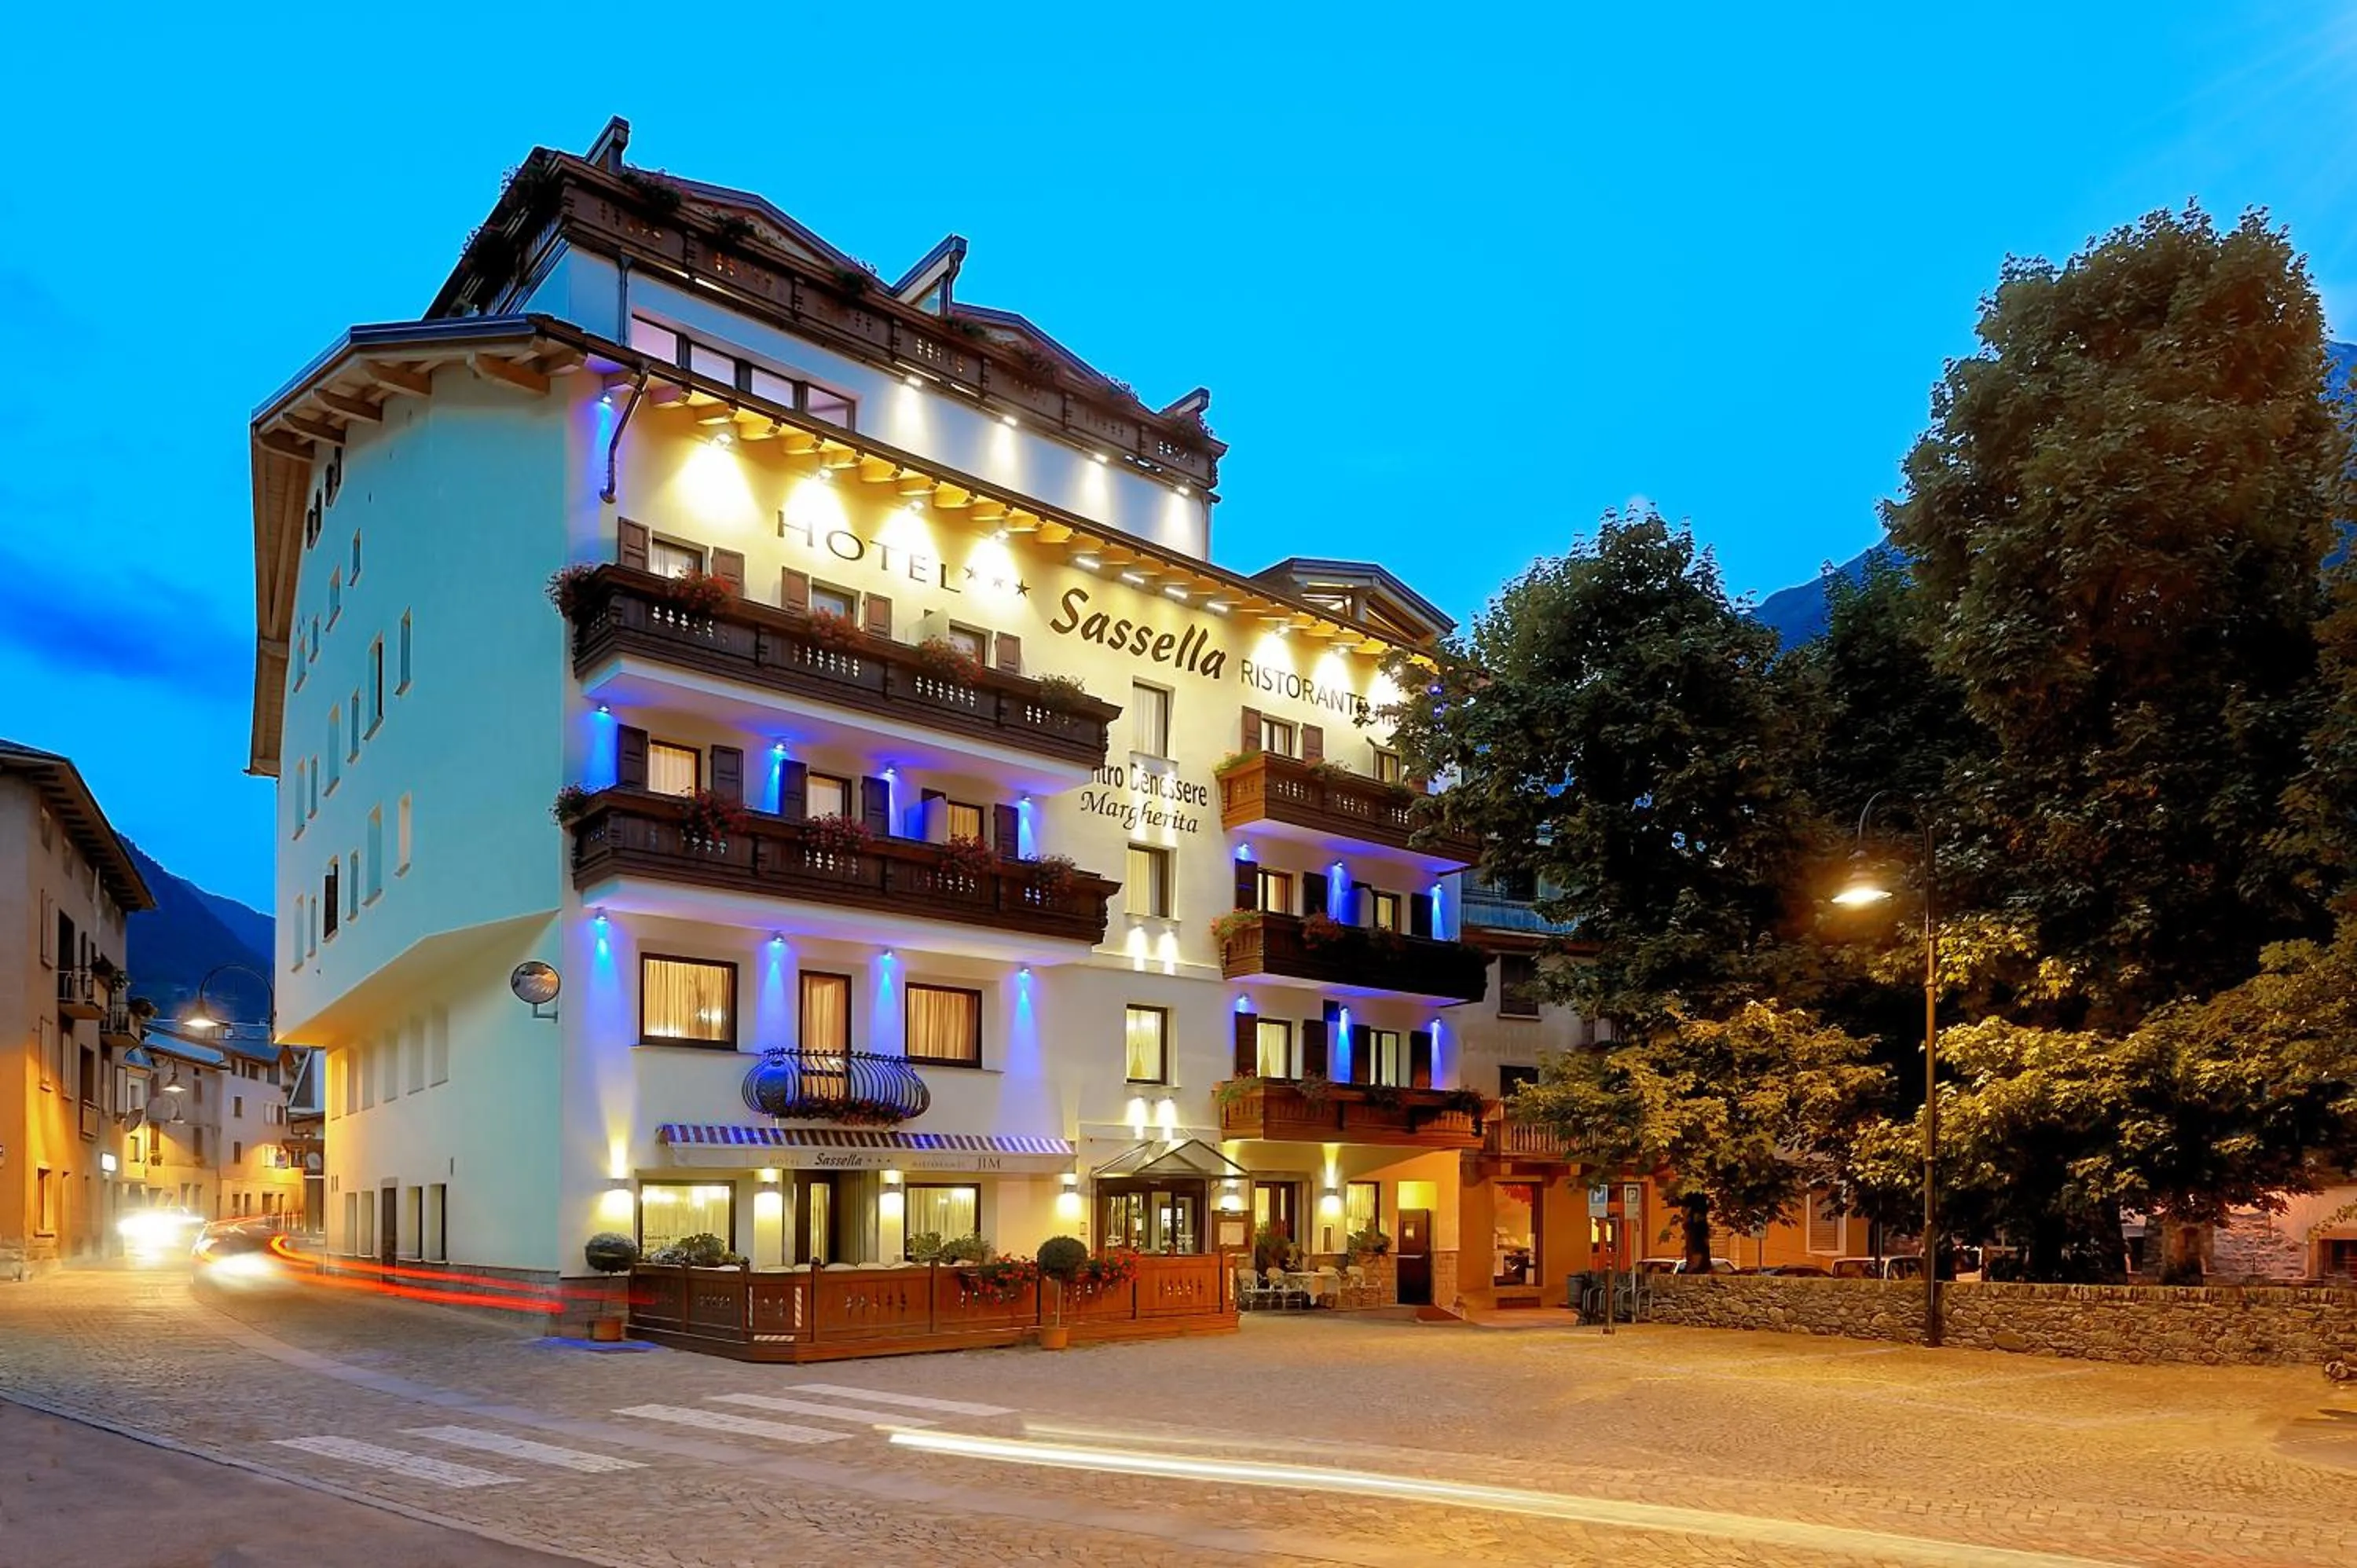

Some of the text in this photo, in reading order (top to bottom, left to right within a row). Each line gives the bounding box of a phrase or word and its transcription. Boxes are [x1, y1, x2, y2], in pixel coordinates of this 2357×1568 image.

[778, 510, 962, 594] HOTEL
[1049, 588, 1226, 680] Sassella
[1091, 765, 1124, 788] ntro
[1080, 791, 1199, 833] Margherita
[814, 1152, 863, 1167] Sassella
[977, 1156, 1000, 1170] JIM
